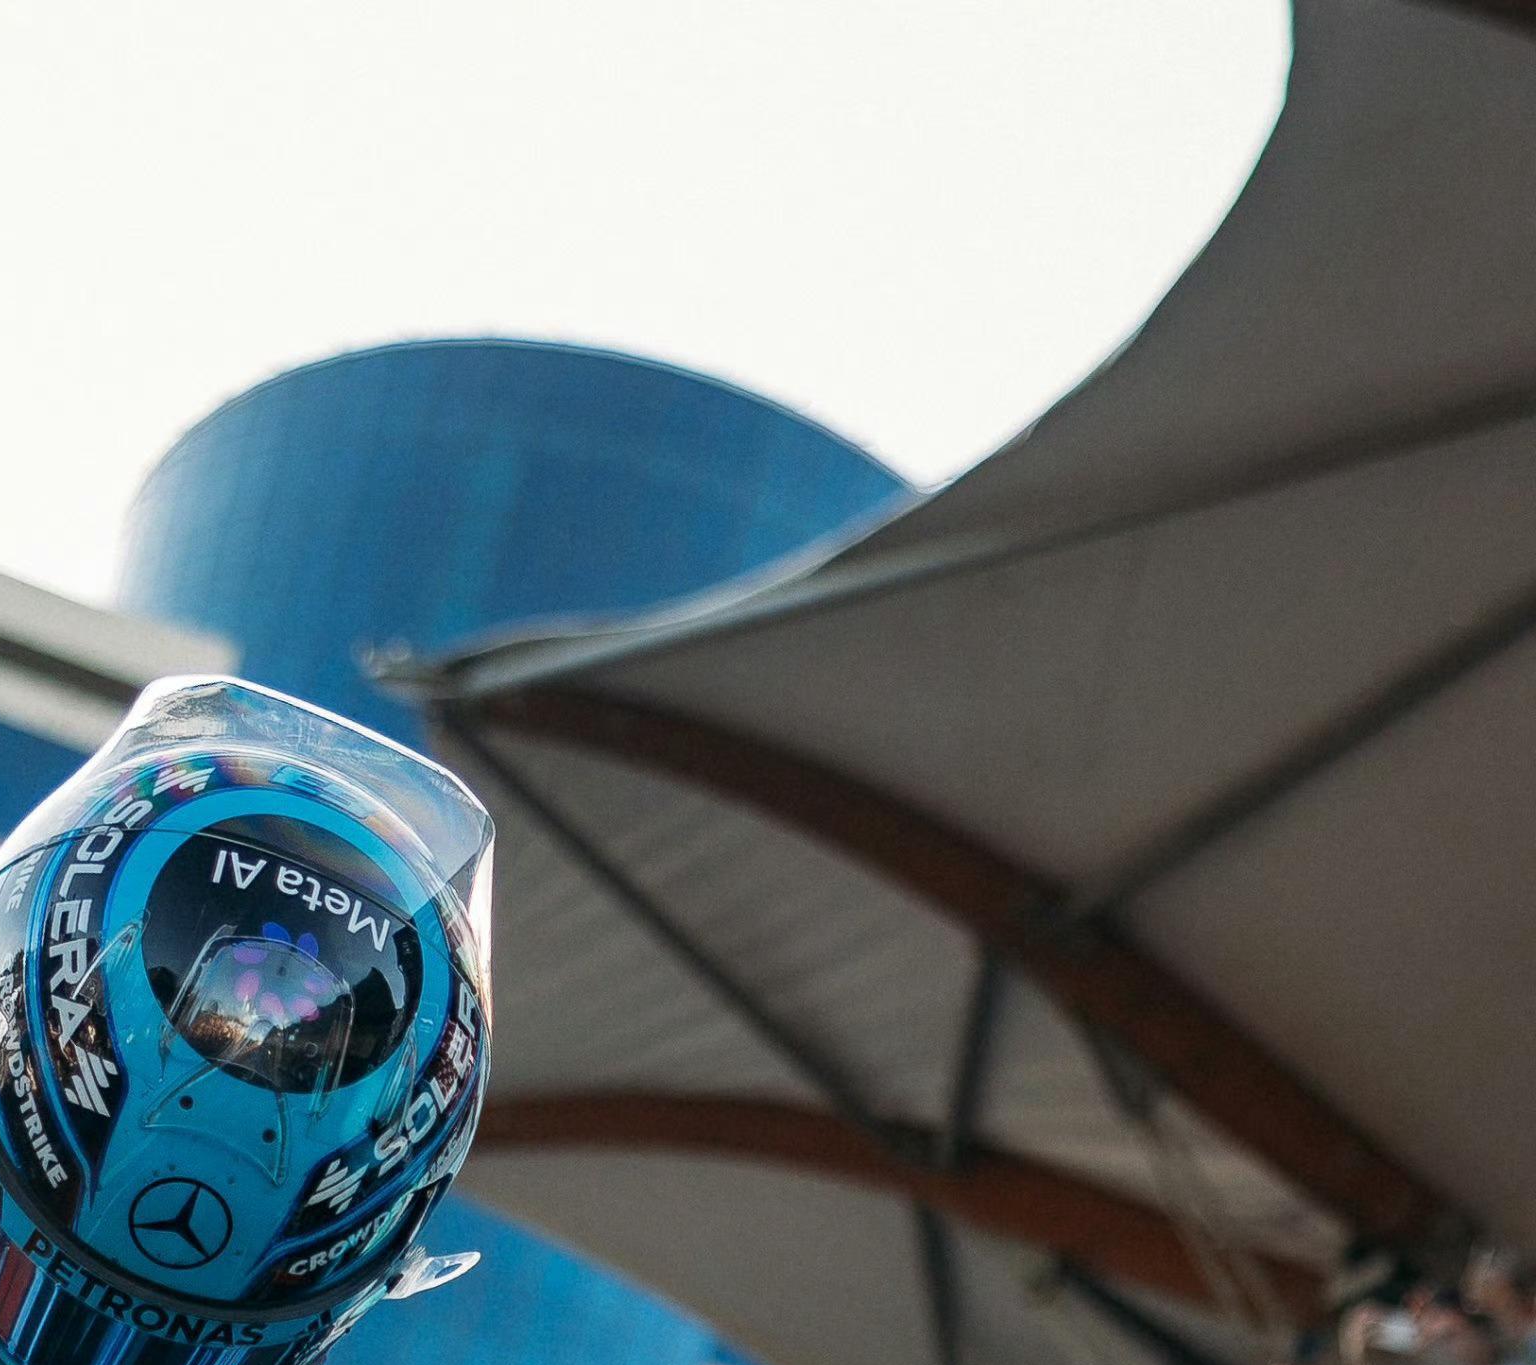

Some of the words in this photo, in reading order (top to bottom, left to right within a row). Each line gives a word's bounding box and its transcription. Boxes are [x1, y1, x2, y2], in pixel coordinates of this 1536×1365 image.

[211, 849, 268, 891] AI
[275, 865, 391, 953] Meta
[48, 795, 154, 1053] SOLERA
[22, 1229, 265, 1347] PETRONAS
